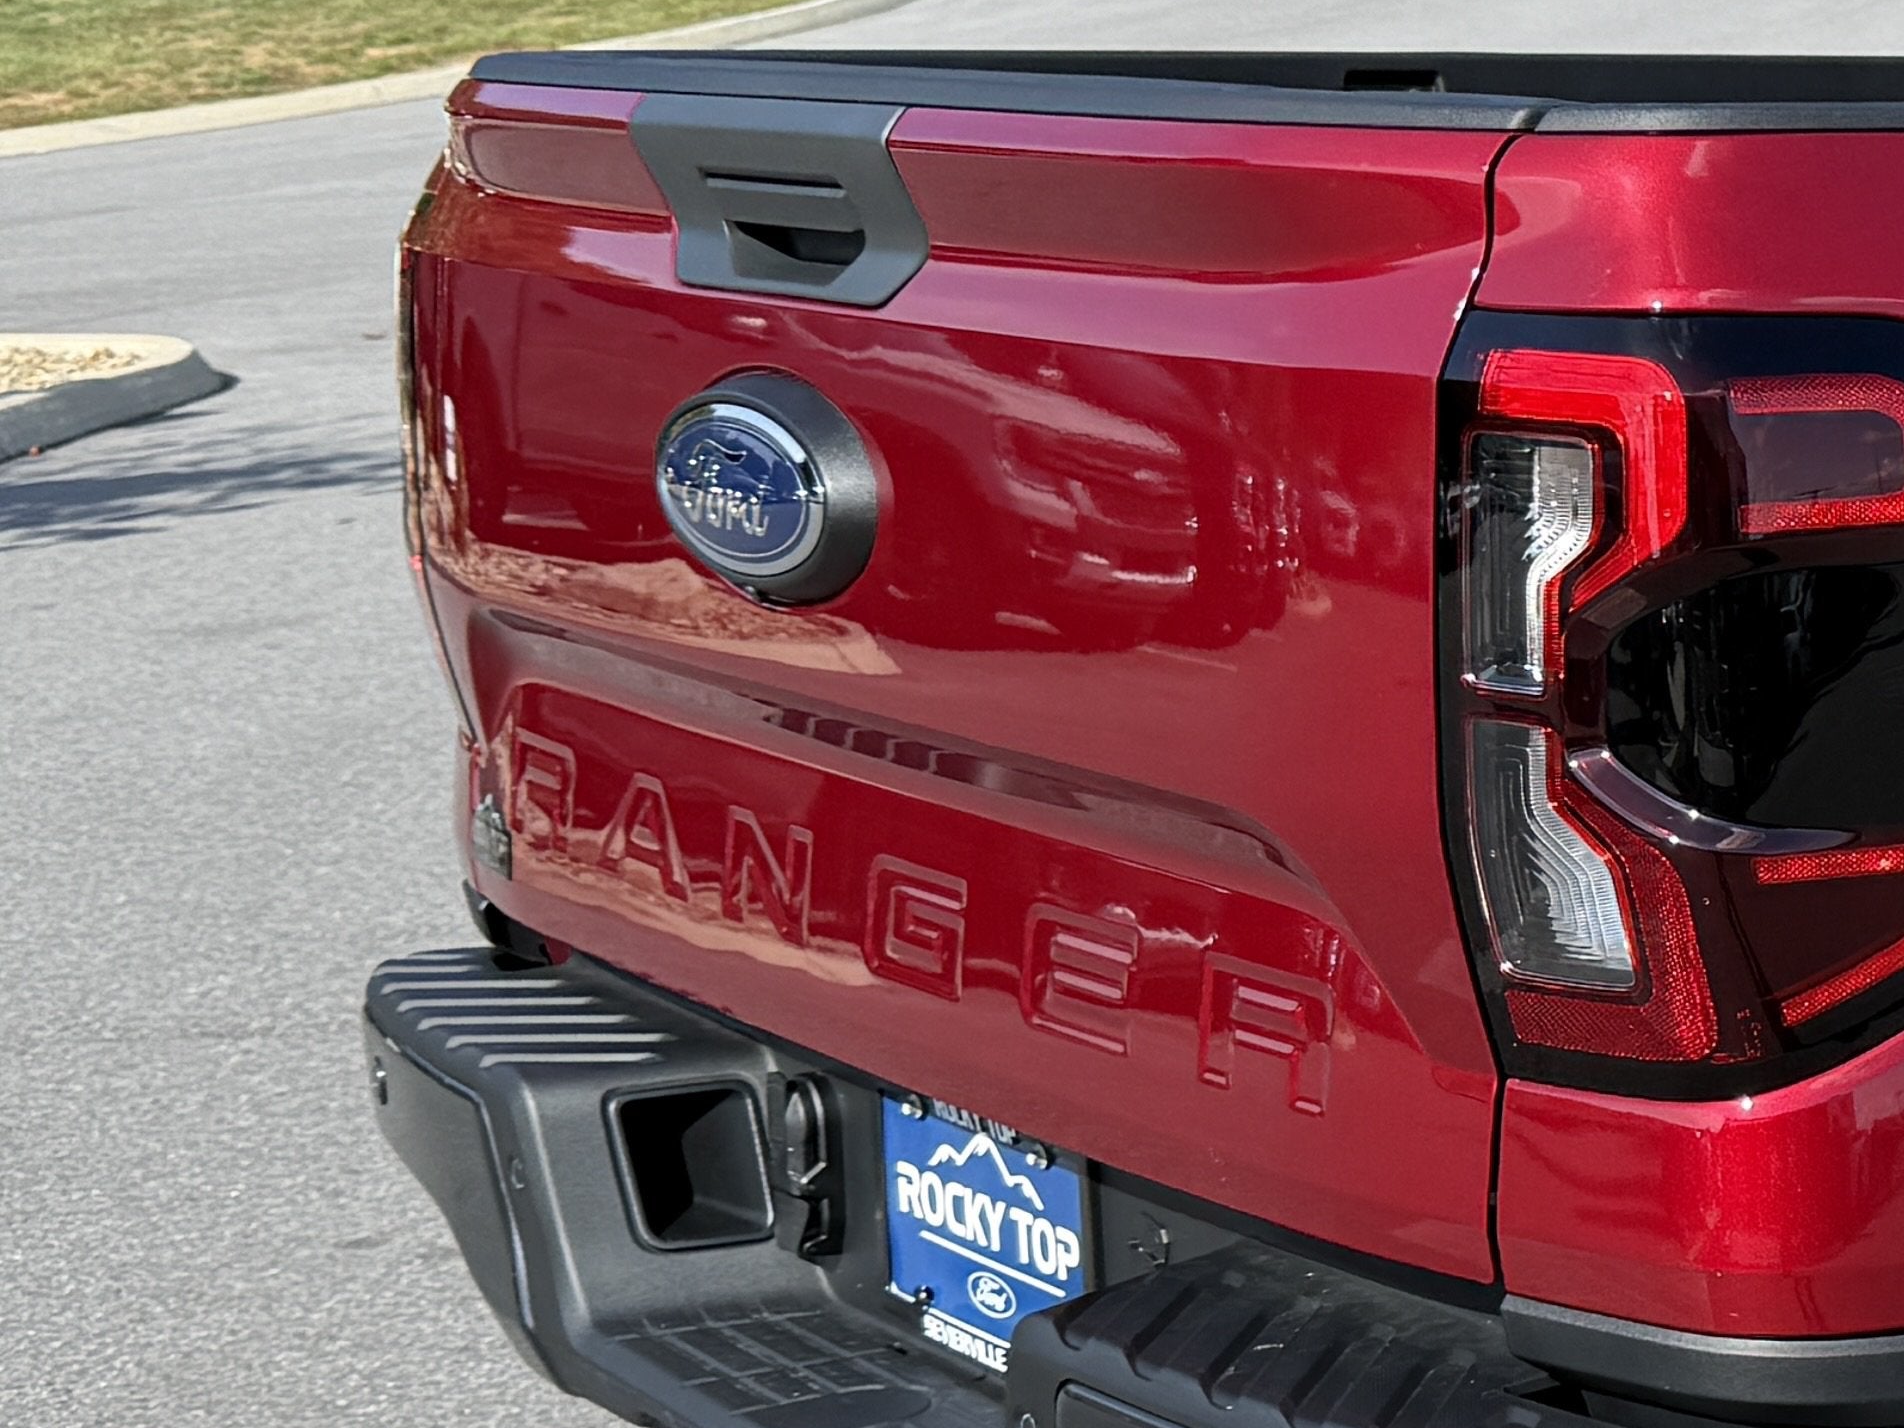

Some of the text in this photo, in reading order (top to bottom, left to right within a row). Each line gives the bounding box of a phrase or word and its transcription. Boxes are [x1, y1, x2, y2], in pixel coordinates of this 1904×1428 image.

[511, 726, 1337, 1118] RANGER
[896, 1160, 1080, 1281] ROCKY TOP
[976, 1277, 1008, 1312] Ford
